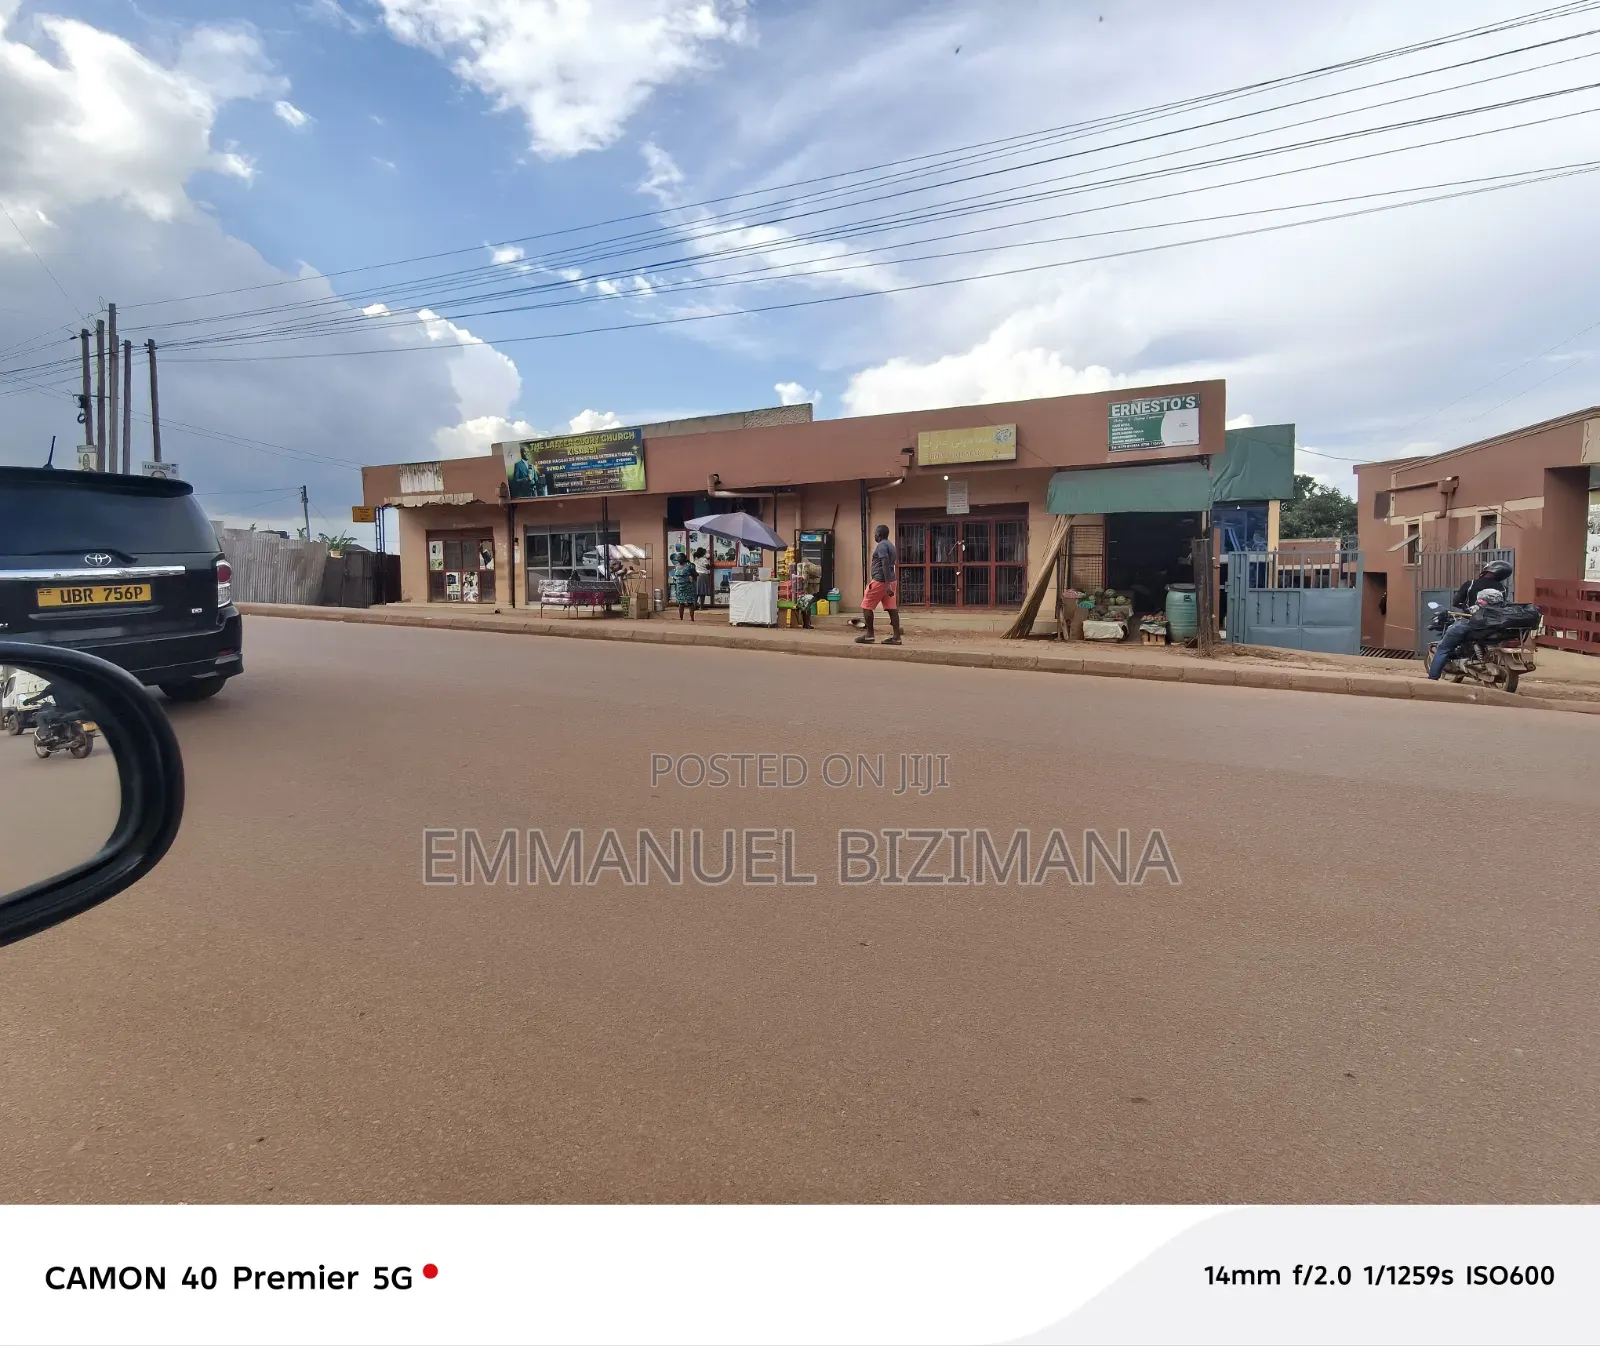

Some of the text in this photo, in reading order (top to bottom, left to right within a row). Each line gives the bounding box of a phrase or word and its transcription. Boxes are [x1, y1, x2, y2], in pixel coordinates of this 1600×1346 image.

[1111, 396, 1196, 417] ERNESTO'S
[529, 442, 545, 452] THE
[574, 435, 601, 446] GLORY
[601, 431, 635, 444] CHURCH
[60, 586, 143, 604] UBR 756P
